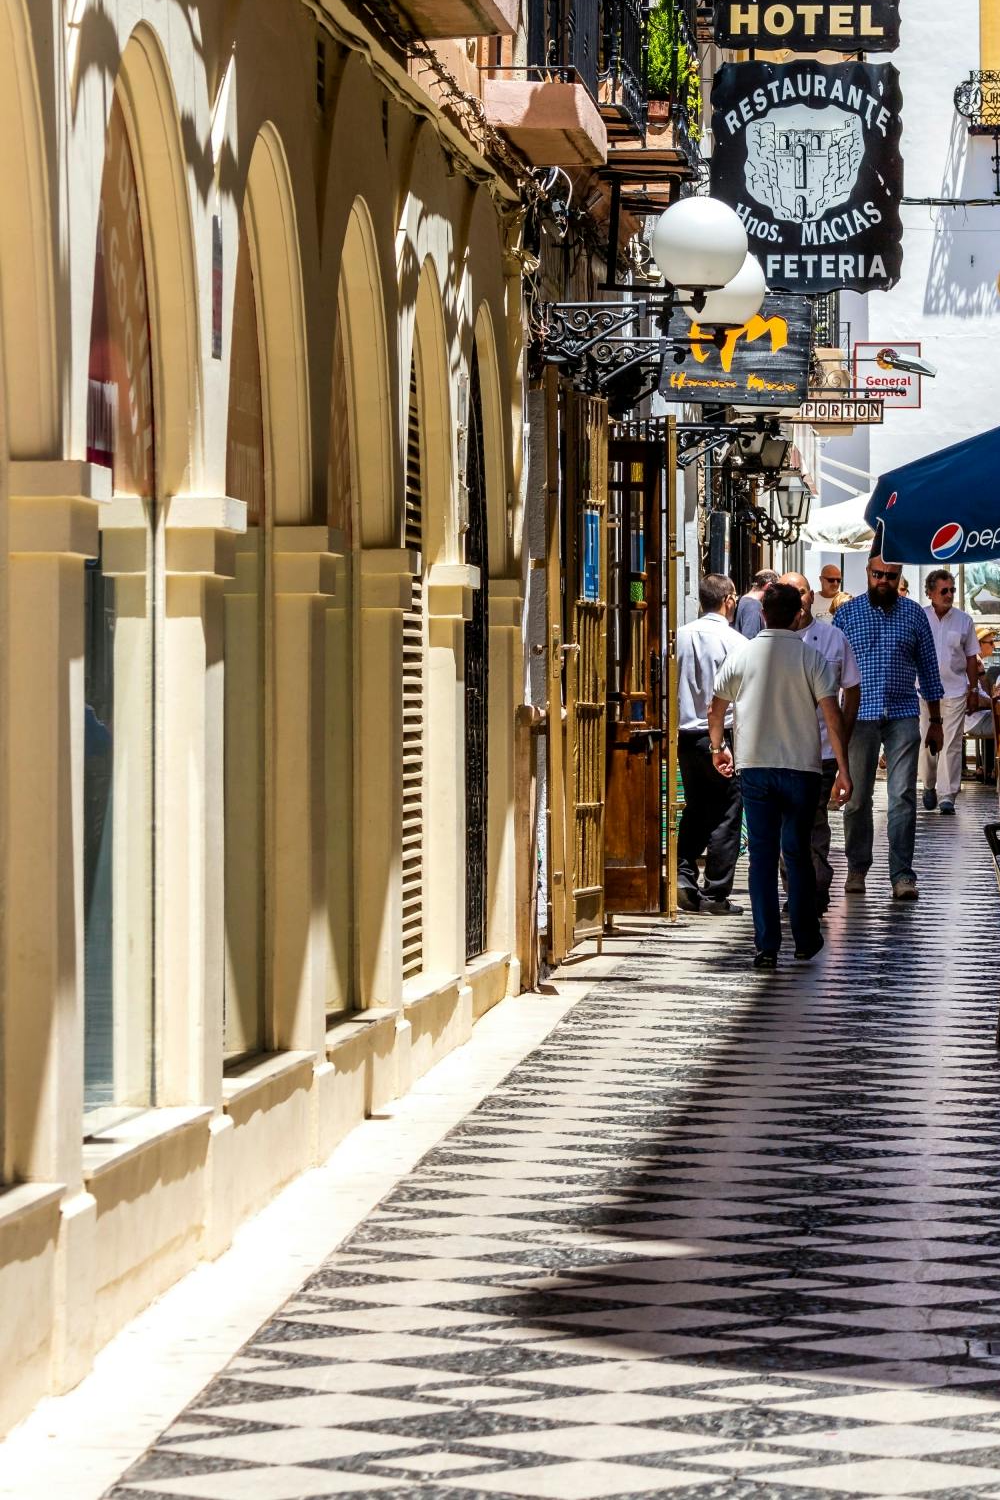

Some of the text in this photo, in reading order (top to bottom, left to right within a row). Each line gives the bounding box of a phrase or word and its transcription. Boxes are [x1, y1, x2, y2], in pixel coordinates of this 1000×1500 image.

[730, 4, 884, 36] HOTEL
[724, 74, 891, 137] RESTAURANTE
[735, 201, 882, 246] Hnos. MACIAS
[757, 255, 887, 278] FETERIA
[866, 376, 912, 386] General
[805, 403, 880, 417] PORTON
